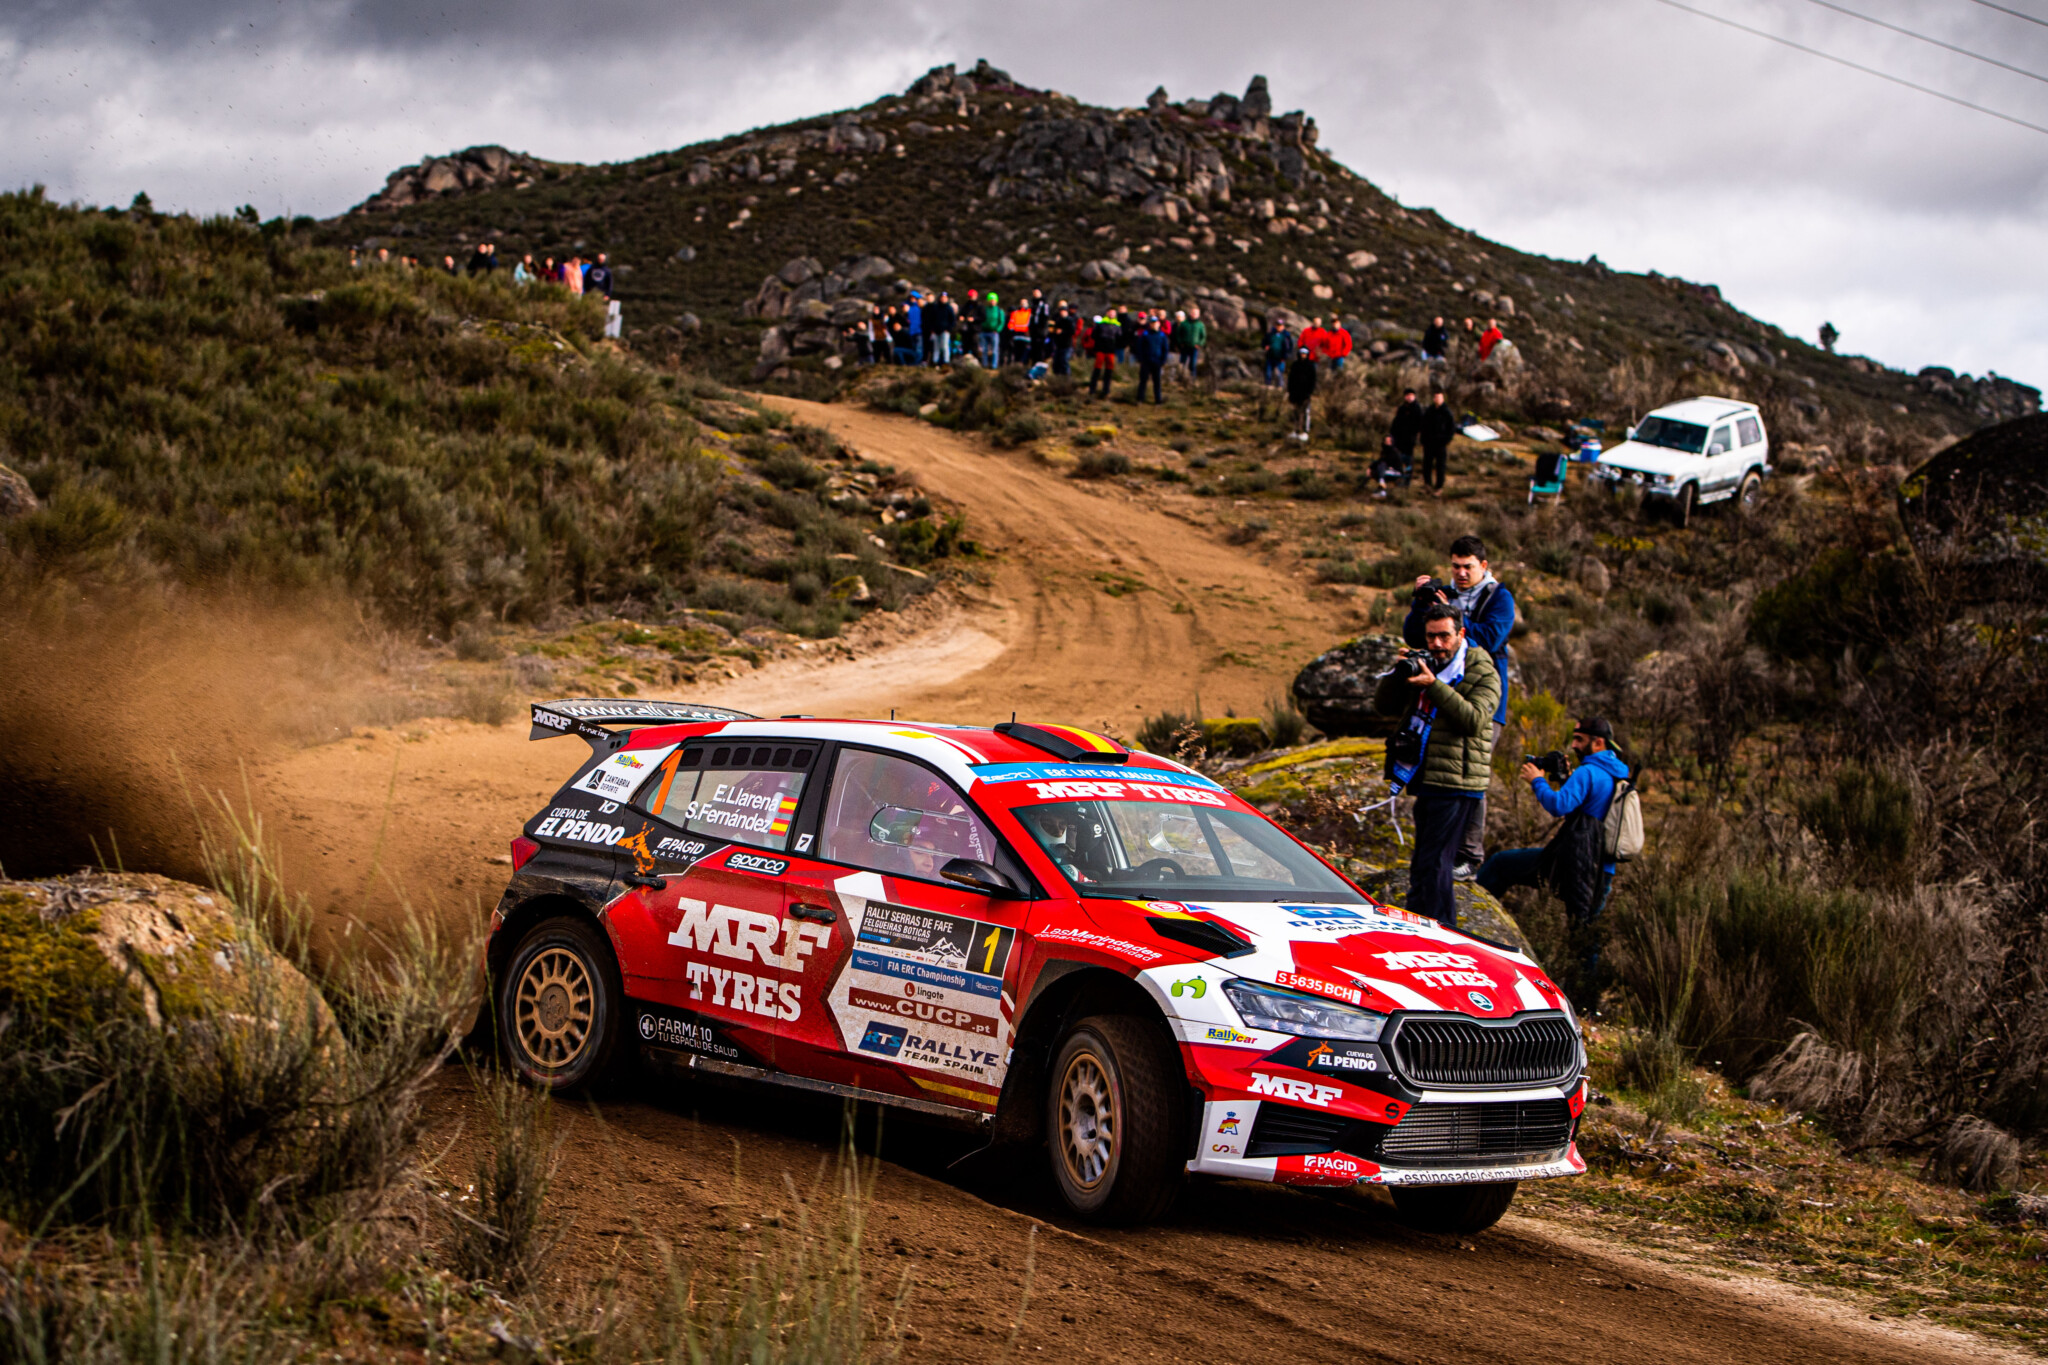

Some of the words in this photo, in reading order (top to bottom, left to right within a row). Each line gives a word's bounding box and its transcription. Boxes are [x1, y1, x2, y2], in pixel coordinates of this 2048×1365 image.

[532, 708, 571, 731] MRF
[616, 754, 644, 769] Rallycar
[604, 774, 630, 788] CANTABRIA
[651, 749, 685, 815] 1
[1070, 770, 1098, 778] LIVE
[600, 782, 618, 794] DEPORTE
[712, 784, 779, 812] E.Llarena
[1027, 781, 1126, 799] MRF
[1127, 784, 1226, 807] TYRES
[550, 808, 576, 819] CUEVA
[576, 810, 590, 820] DE
[685, 800, 772, 834] S.Fernández
[534, 817, 556, 837] EL
[555, 819, 625, 846] PENDO
[652, 850, 698, 862] RACING
[667, 839, 706, 855] PAGID
[730, 853, 785, 872] sparco
[864, 918, 902, 933] FELGUEIRAS
[902, 926, 931, 938] BOTICAS
[866, 906, 891, 920] RALLY
[891, 912, 921, 927] SERRAS
[922, 918, 934, 929] DE
[934, 922, 954, 933] FAFE
[667, 896, 832, 972] MRF
[1041, 924, 1162, 958] LasMerindades
[984, 928, 1000, 974] 1
[1372, 951, 1478, 970] MRF
[888, 961, 900, 972] FIA
[902, 964, 915, 976] ERC
[917, 967, 966, 987] Championship
[1410, 970, 1498, 988] TYRES
[686, 961, 801, 1022] TYRES
[918, 986, 944, 1000] lingote
[1278, 972, 1287, 983] S
[1290, 974, 1323, 991] 5635
[1324, 984, 1352, 1000] BCH
[856, 998, 990, 1034] www.CUCP.pt
[658, 1032, 669, 1042] TU
[703, 1042, 713, 1052] DE
[714, 1045, 738, 1058] SALUD
[1208, 1028, 1258, 1044] Rallycar
[904, 1050, 940, 1064] TEAM
[943, 1059, 984, 1074] SPAIN
[906, 1035, 999, 1066] RALLYE
[1346, 1050, 1365, 1058] CUEVA
[1318, 1054, 1332, 1066] EL
[1334, 1056, 1378, 1071] PENDO
[1246, 1072, 1343, 1107] MRF
[1317, 1157, 1357, 1172] PAGID
